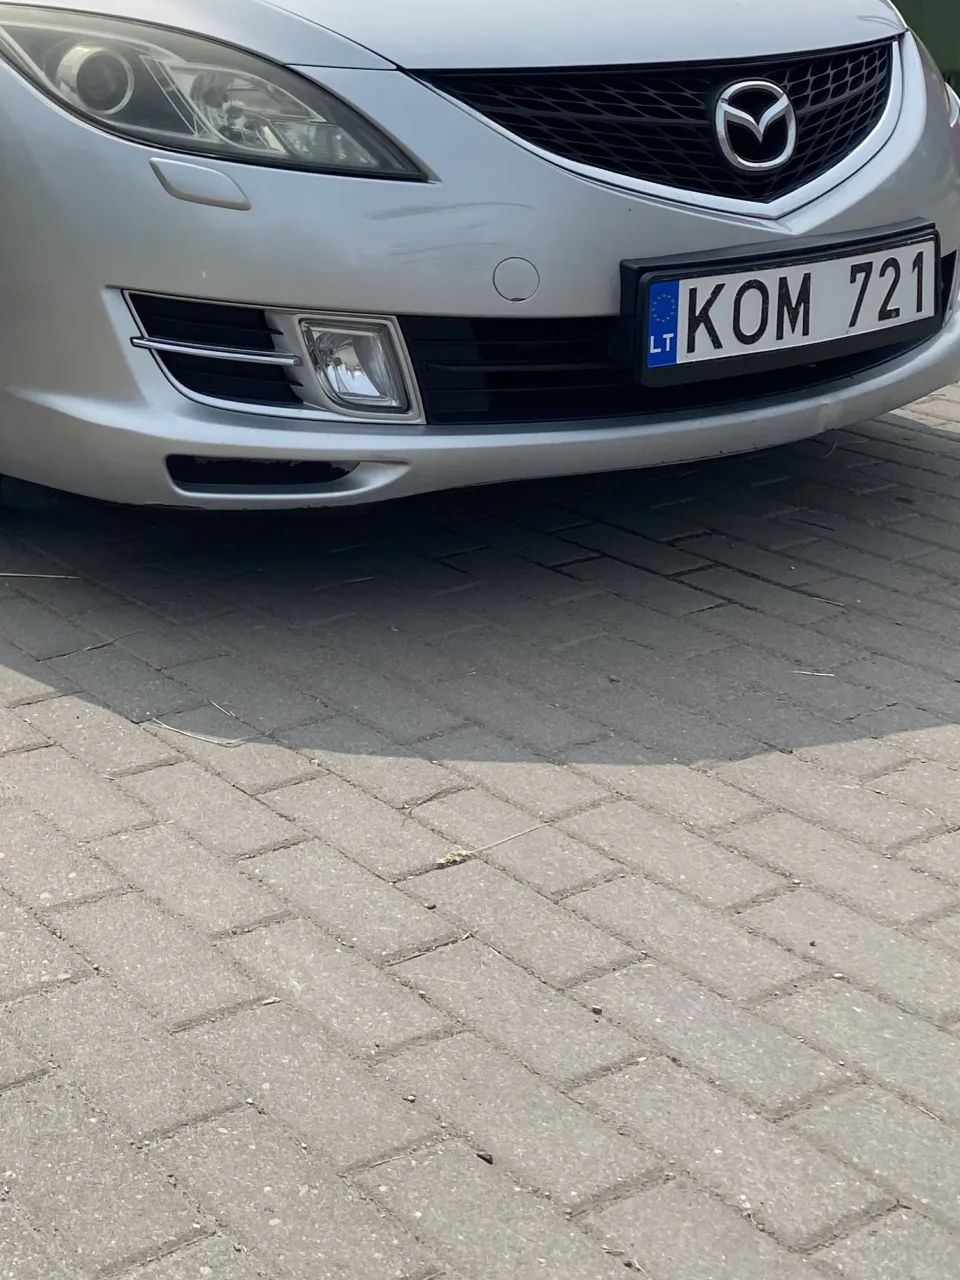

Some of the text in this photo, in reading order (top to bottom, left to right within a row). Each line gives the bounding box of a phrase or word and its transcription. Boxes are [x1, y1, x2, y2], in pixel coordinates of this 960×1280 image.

[686, 251, 925, 354] KOM 721
[649, 332, 675, 354] LT
